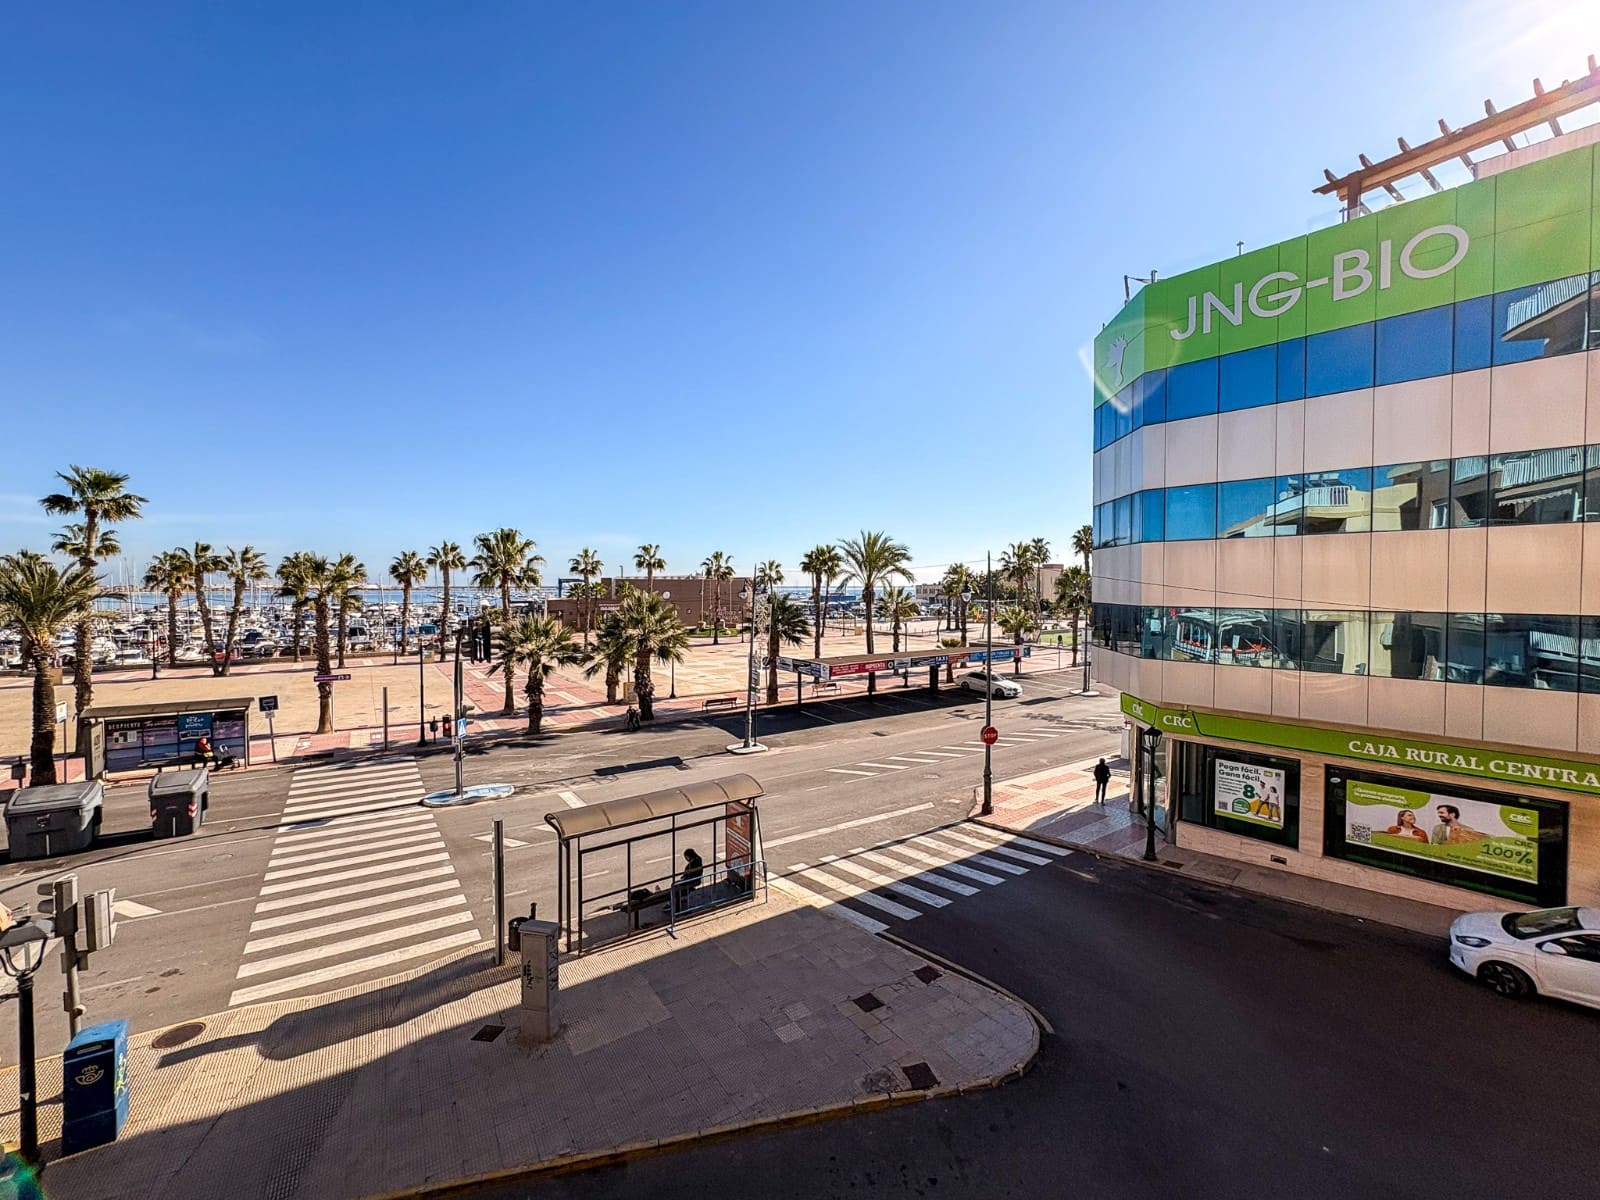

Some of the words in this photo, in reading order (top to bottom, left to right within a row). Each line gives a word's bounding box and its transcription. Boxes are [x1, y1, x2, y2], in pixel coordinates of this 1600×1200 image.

[1168, 223, 1470, 342] JNG-BIO
[1162, 714, 1192, 728] CRC
[1348, 739, 1401, 759] CAJA
[1405, 747, 1485, 772] RURAL
[1242, 784, 1255, 799] 8
[1480, 843, 1533, 865] 100%
